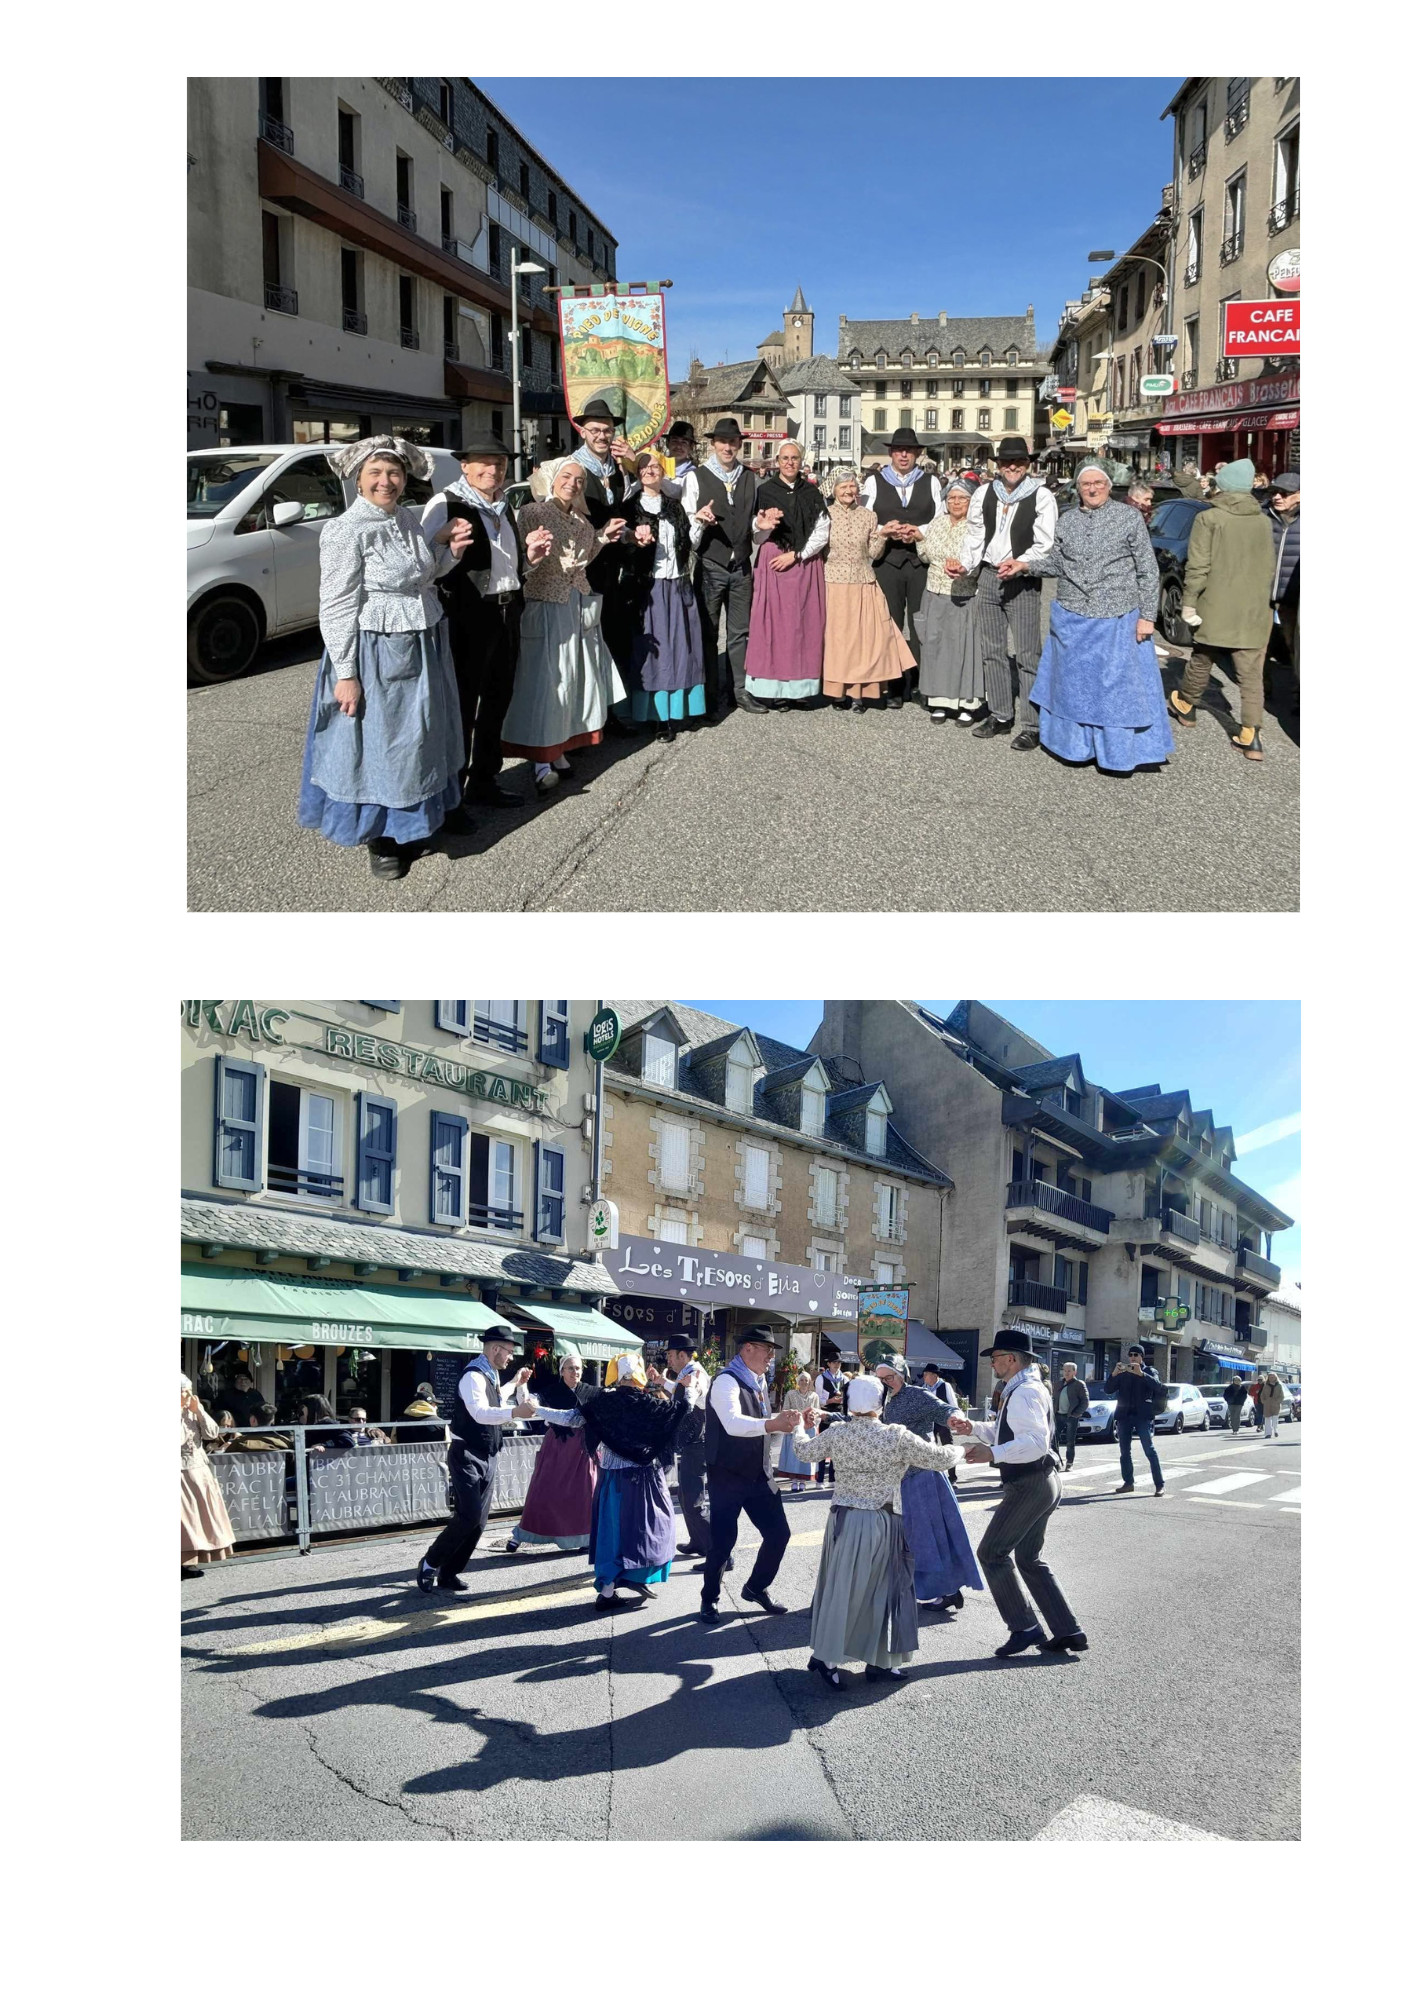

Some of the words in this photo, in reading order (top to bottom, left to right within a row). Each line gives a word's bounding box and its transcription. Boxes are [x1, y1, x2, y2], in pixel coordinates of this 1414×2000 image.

[573, 314, 601, 338] PIED
[604, 308, 619, 321] DE
[622, 314, 659, 341] VIGNE
[1250, 308, 1293, 323] CAFE
[1228, 329, 1300, 343] FRANCAI
[627, 402, 665, 447] BRIOUDE
[181, 1000, 291, 1046] RAC
[326, 1026, 549, 1112] RESTAURANT
[618, 1246, 673, 1279] Les
[183, 1313, 213, 1333] RAC
[312, 1322, 373, 1342] BROUZES
[1011, 1322, 1051, 1338] PHARMACIE
[586, 1341, 611, 1357] HOTEL
[365, 1451, 436, 1468] L'AUBRAC
[336, 1473, 351, 1487] 31
[356, 1466, 434, 1485] CHAMBRES
[226, 1494, 260, 1513] AFÉ
[325, 1485, 398, 1504] L'AUBRAC
[311, 1503, 383, 1521] 'AUBRAC
